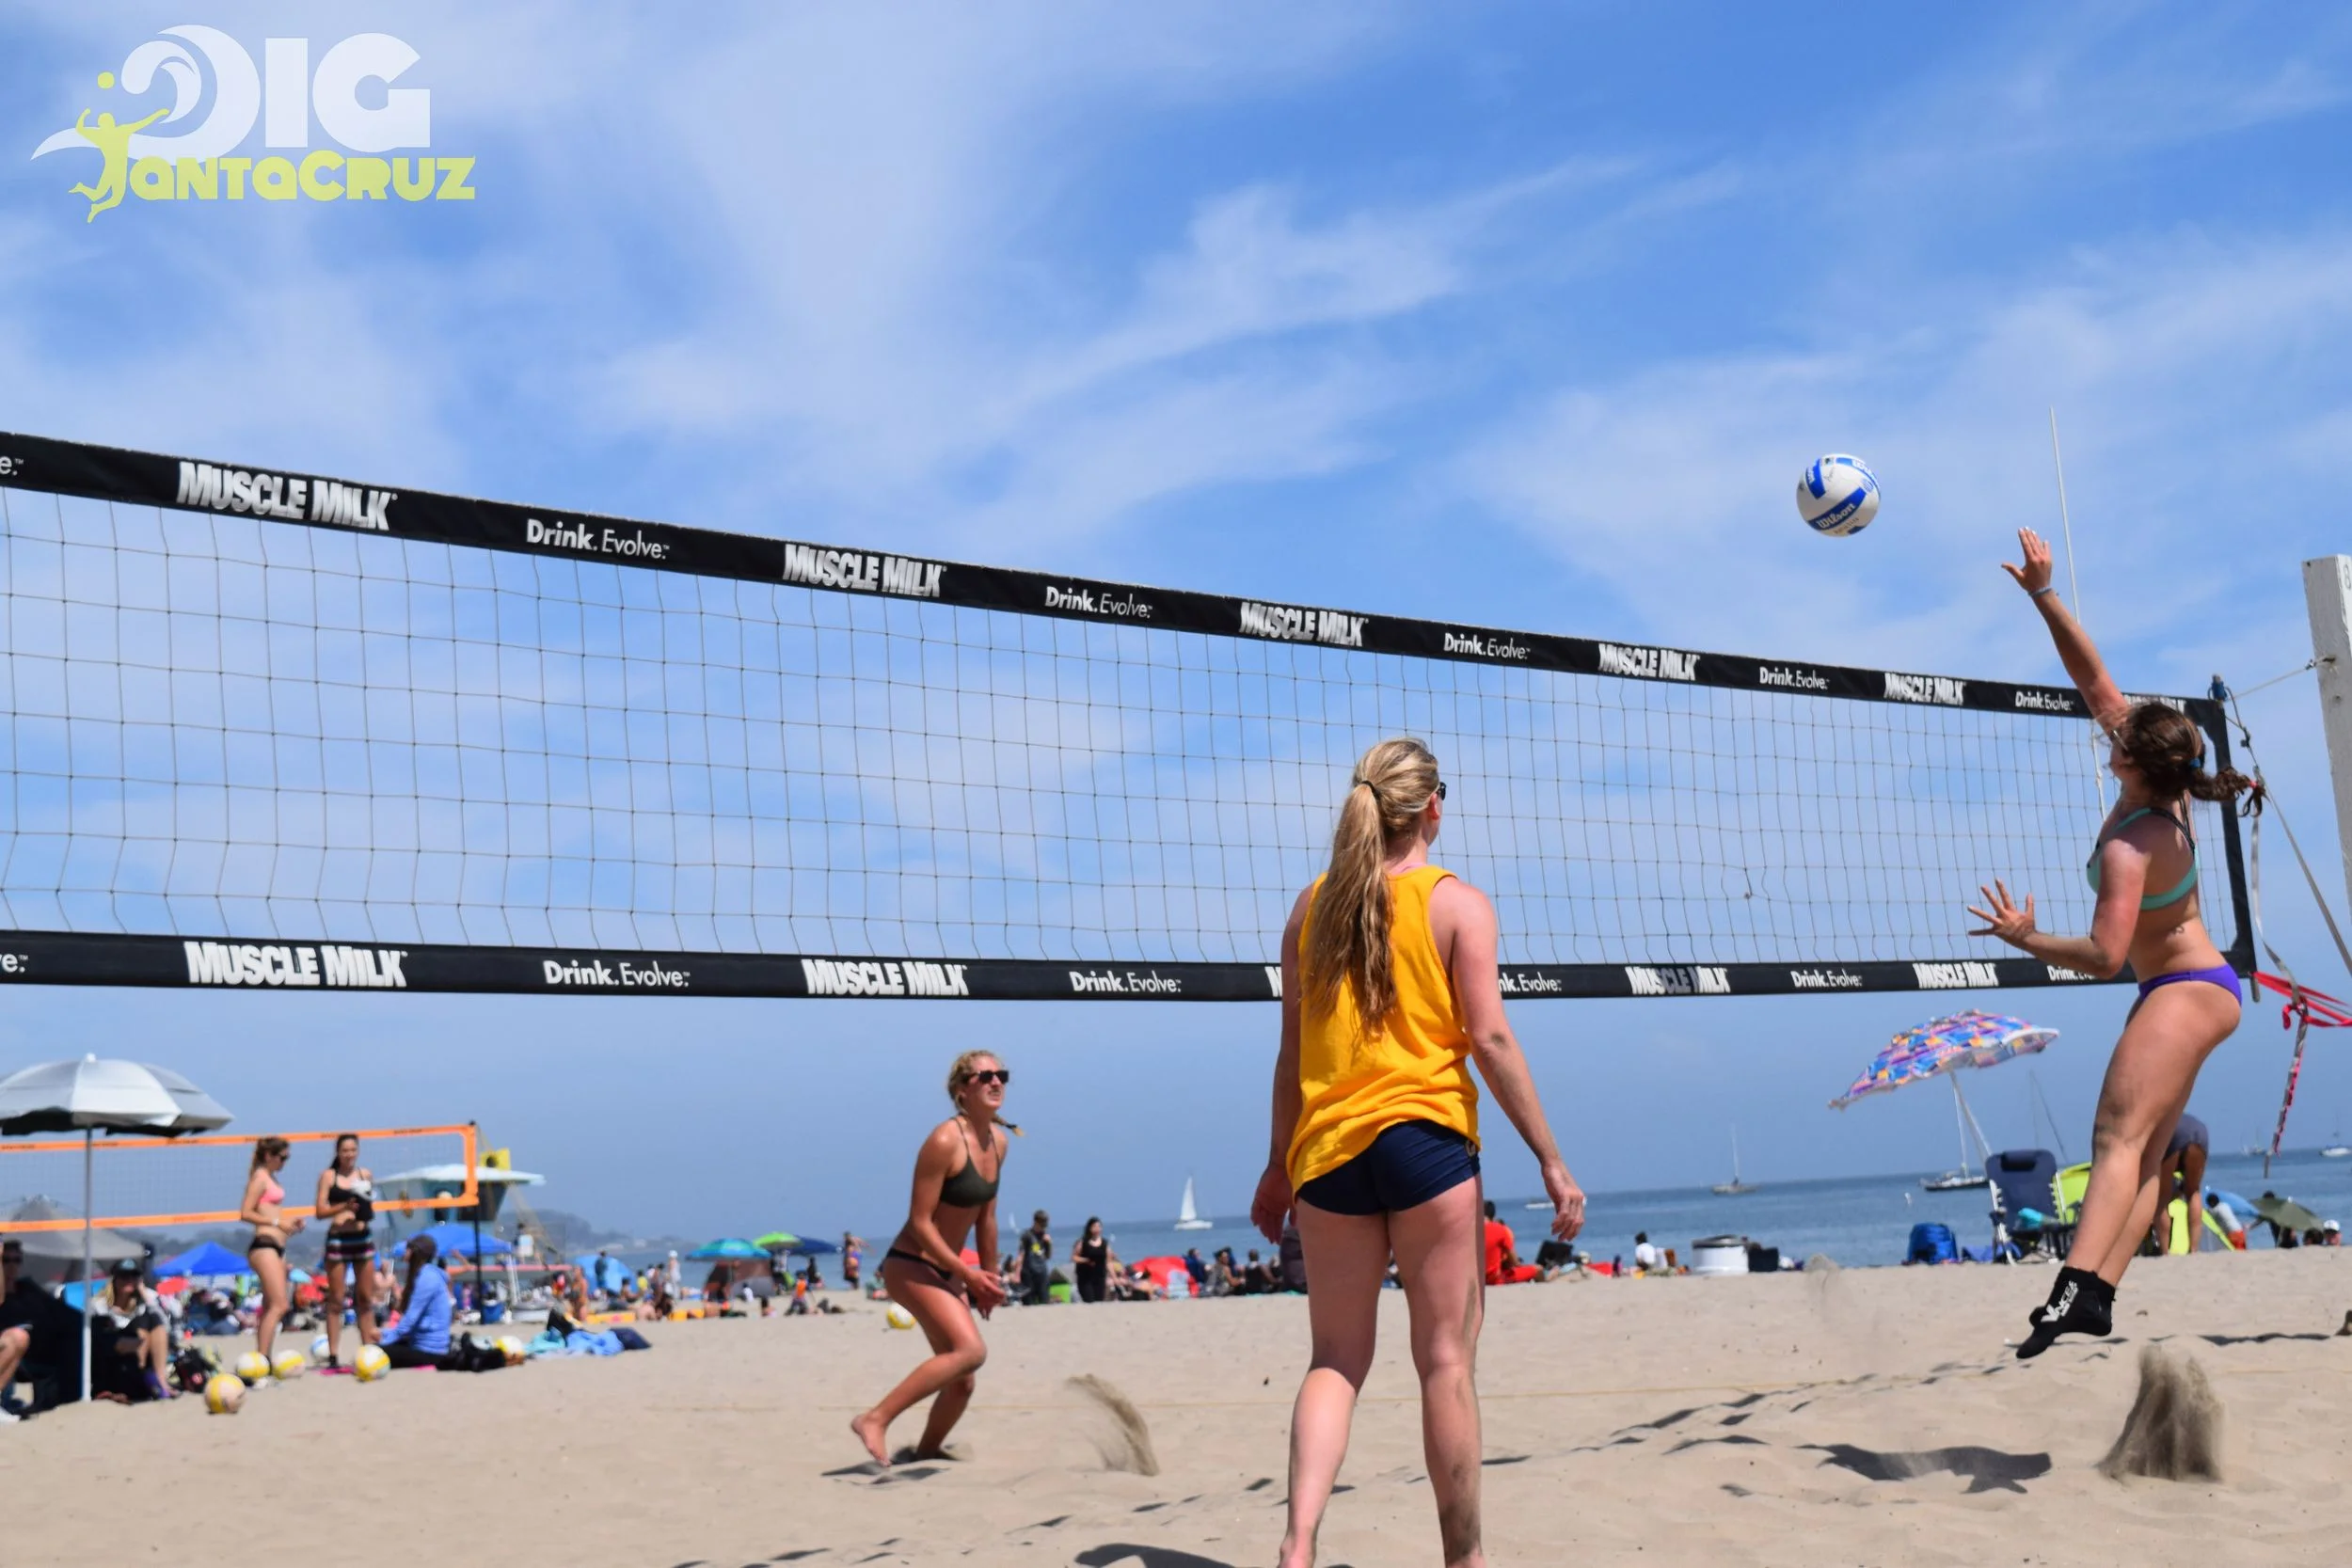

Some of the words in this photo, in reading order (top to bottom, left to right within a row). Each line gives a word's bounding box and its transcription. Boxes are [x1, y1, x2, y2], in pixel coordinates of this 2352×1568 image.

[177, 461, 308, 520] MUSCLE
[311, 483, 390, 531] MILK
[782, 544, 880, 591] MUSCLE
[882, 556, 943, 597] MILK
[1239, 601, 1316, 641] MUSCLE
[1318, 610, 1365, 646] MILK
[1597, 643, 1659, 677] MUSCLE
[1659, 649, 1697, 680] MILK
[1883, 672, 1933, 702] MUSCLE
[1934, 676, 1964, 705] MILK
[183, 941, 322, 987] MUSCLE
[325, 944, 407, 988] MILK
[801, 958, 904, 995] MUSCLE
[905, 960, 970, 996] MILK
[1625, 966, 1692, 995] MUSCLE
[1688, 965, 1730, 993] MILK
[1912, 962, 1966, 990] MUSCLE
[1966, 961, 1998, 988] MILK
